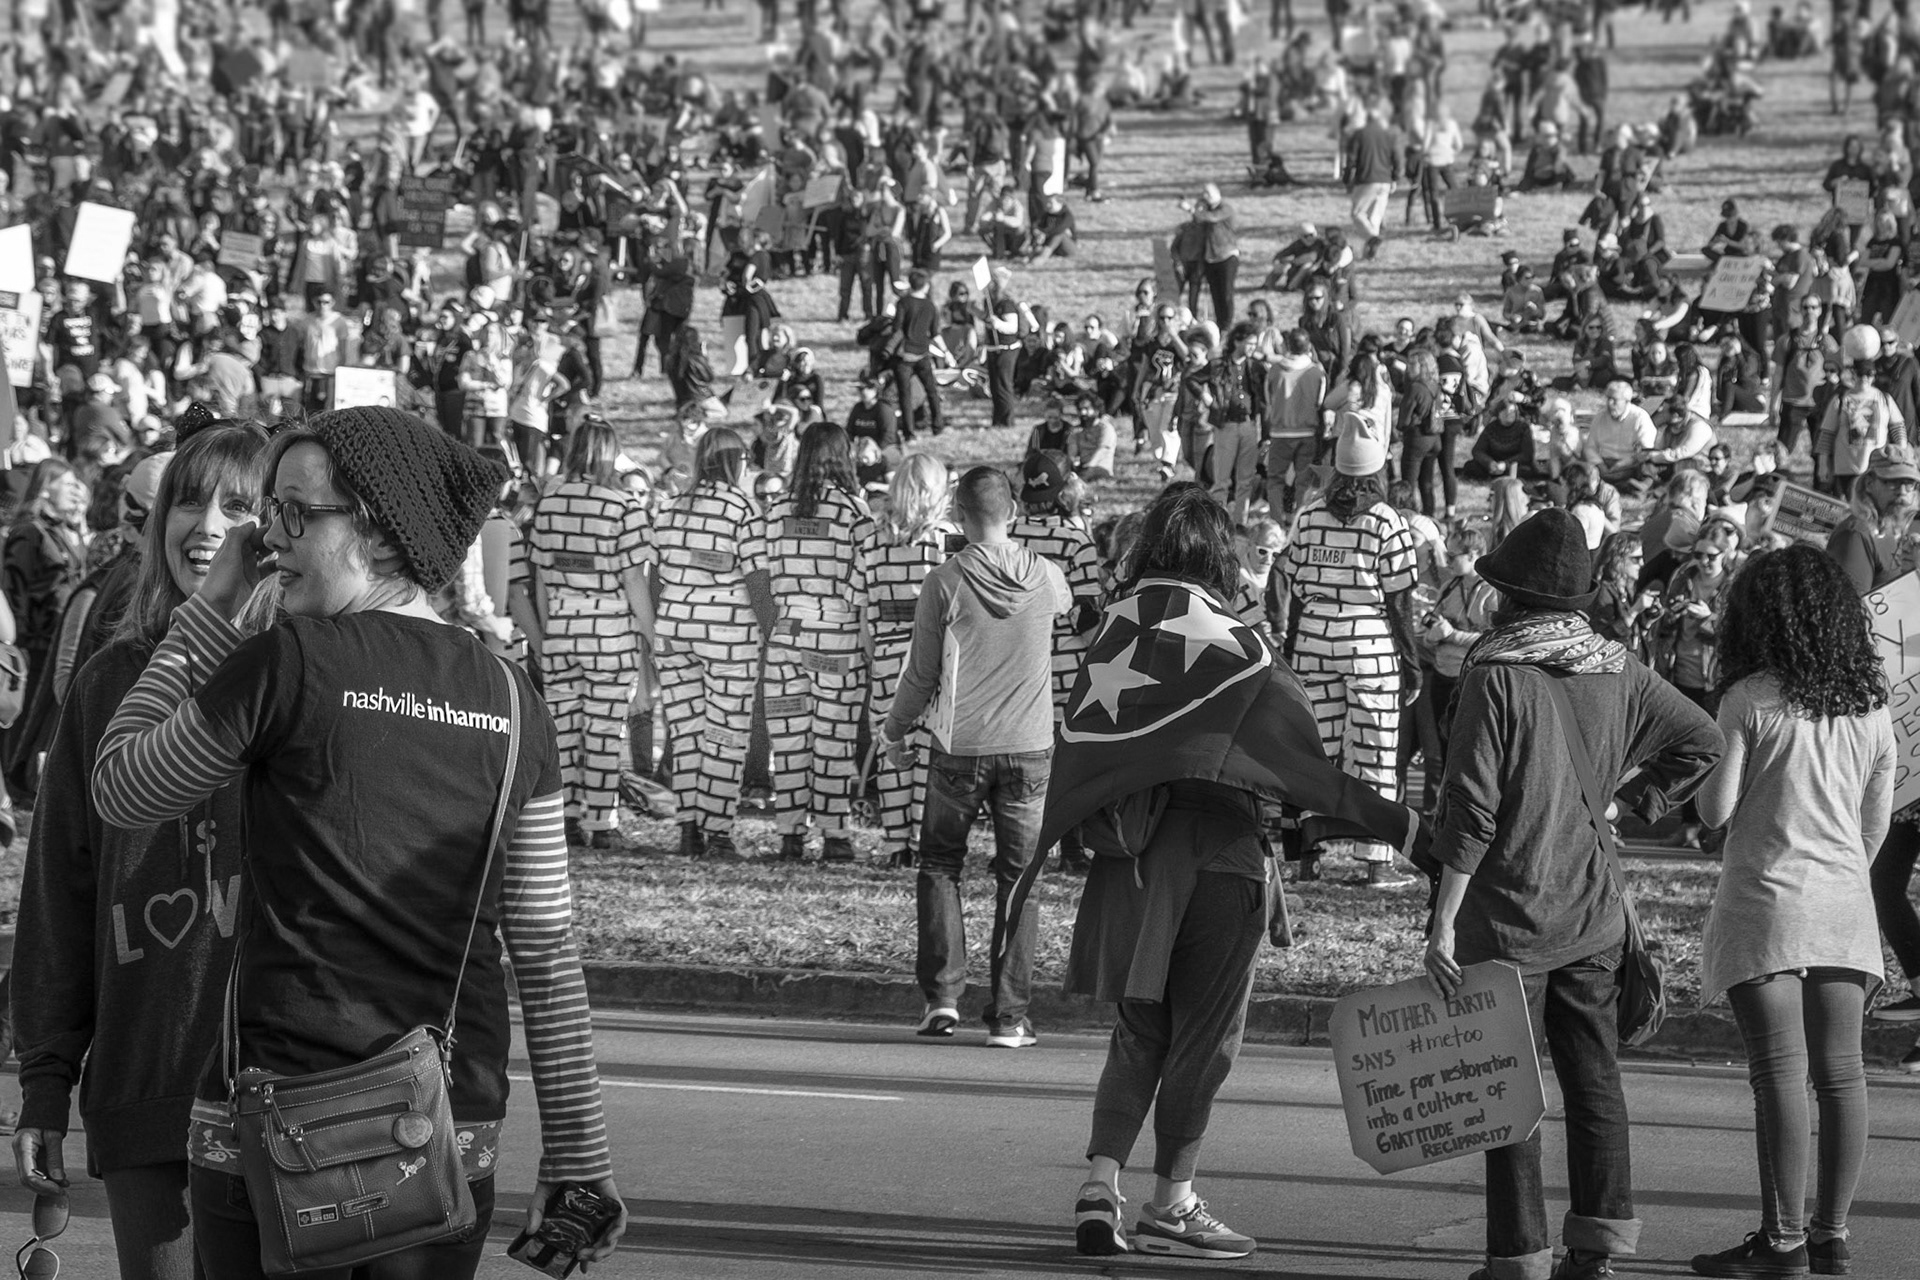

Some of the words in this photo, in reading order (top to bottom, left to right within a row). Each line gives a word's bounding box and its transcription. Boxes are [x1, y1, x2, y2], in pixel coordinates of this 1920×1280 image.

[1312, 548, 1347, 564] BIMBO
[1357, 1002, 1437, 1038] MOTHER
[1445, 990, 1497, 1018] EARTH
[1407, 1025, 1483, 1053] #metoo
[1357, 1079, 1405, 1107] Time
[1410, 1072, 1435, 1100] for
[1440, 1055, 1518, 1083] restoration
[1366, 1107, 1399, 1129] into
[1403, 1106, 1413, 1121] a
[1417, 1090, 1478, 1118] culture
[1486, 1081, 1507, 1100] of
[1376, 1121, 1453, 1154] GRATITUDE
[1464, 1108, 1485, 1128] and
[1421, 1125, 1512, 1158] RECIPROCITY
